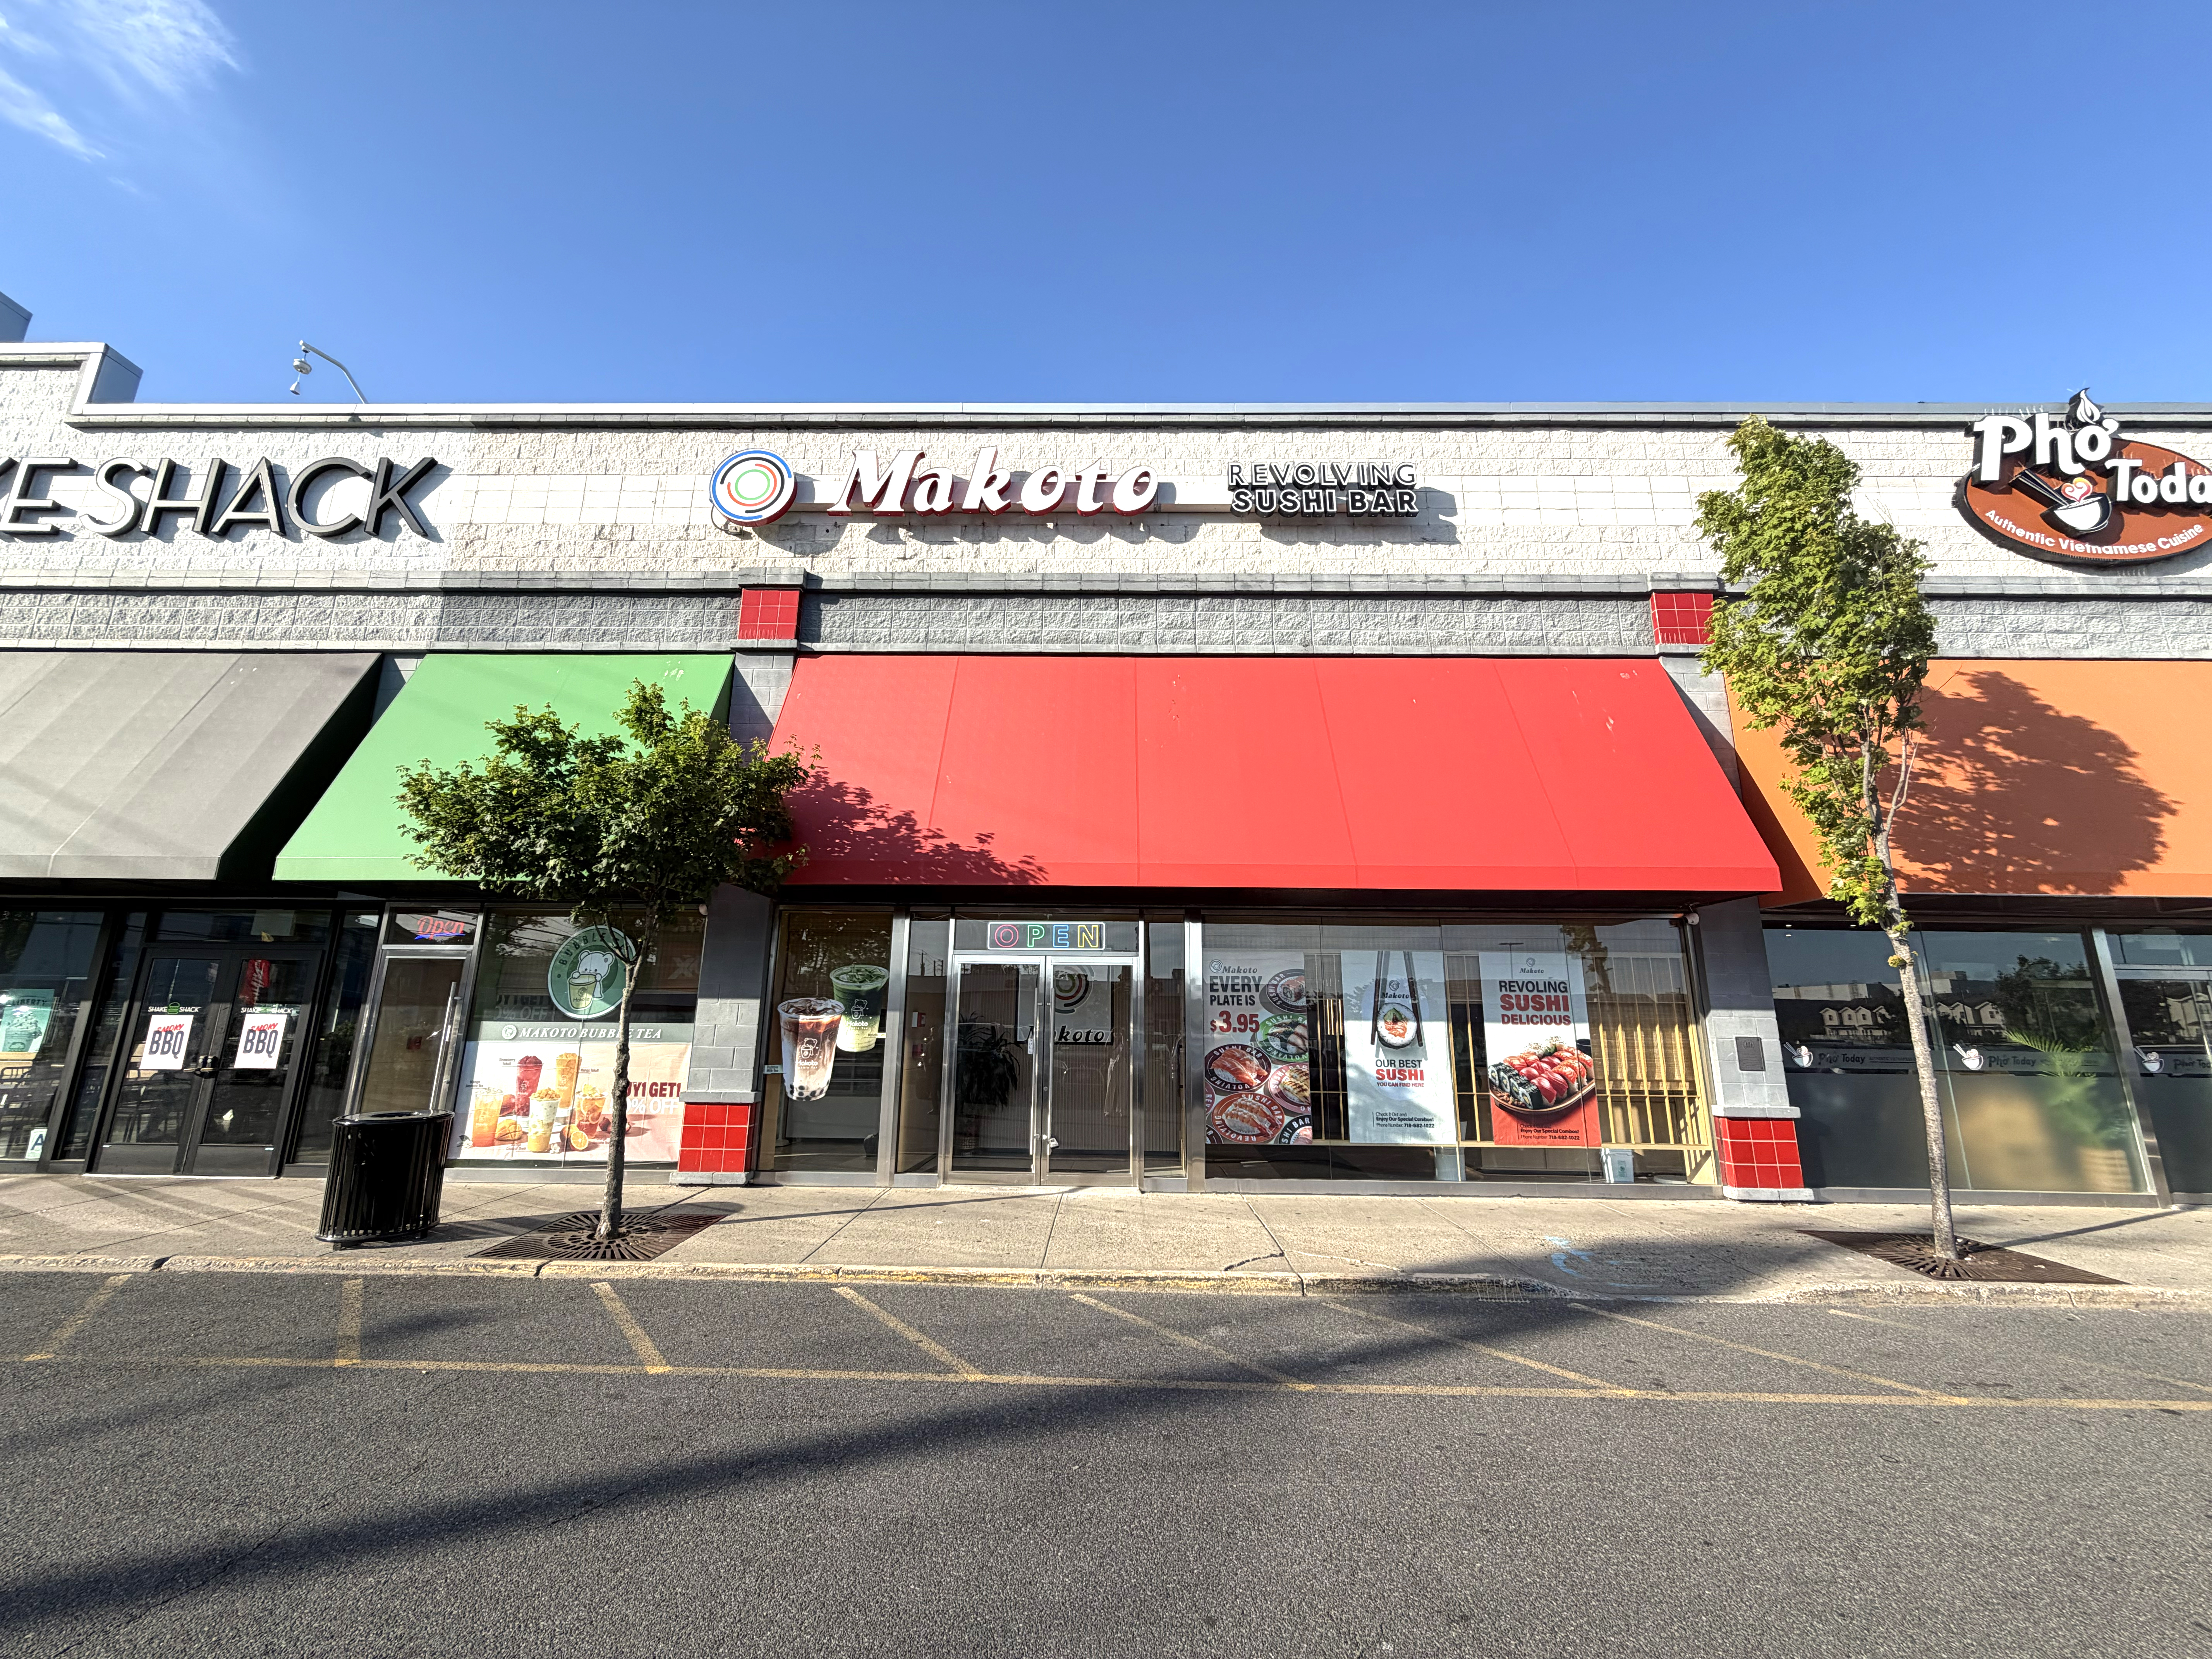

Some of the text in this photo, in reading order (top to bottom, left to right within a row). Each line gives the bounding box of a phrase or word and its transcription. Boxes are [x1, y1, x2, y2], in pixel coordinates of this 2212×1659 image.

[827, 445, 1158, 517] Makoto
[1228, 462, 1418, 489] REVOLVING
[0, 456, 439, 537] E SHACK
[1230, 489, 1419, 517] SUSHI BAR
[1985, 510, 2203, 555] Authentic Vietnamese Cuisine
[417, 916, 465, 941] Open
[994, 924, 1099, 948] OPEN
[1209, 975, 1262, 993] EVERY
[1271, 973, 1286, 984] BAR
[1499, 980, 1568, 993] REVOLING
[1210, 994, 1255, 1006] PLATE IS
[1500, 994, 1570, 1012] SUSHI
[1210, 1010, 1260, 1033] $3.95
[1266, 1015, 1293, 1026] SUSHI
[1501, 1014, 1571, 1026] DELICIOUS
[519, 1027, 662, 1039] MAKOTO BUBBE TEA
[1025, 1025, 1104, 1042] koto
[148, 1030, 184, 1059] BBQ
[242, 1029, 278, 1058] BBQ
[1213, 1045, 1262, 1058] SUSHI BAR
[1375, 1059, 1422, 1068] OUR BEST
[1841, 1053, 1865, 1064] Today
[2011, 1056, 2036, 1066] Today
[1210, 1076, 1262, 1090] RVOLVING
[1376, 1068, 1424, 1081] SUSHI
[649, 1097, 678, 1114] OFF
[1241, 1094, 1272, 1105] SUSHI
[1292, 1117, 1310, 1128] BAR
[30, 1133, 44, 1151] A
